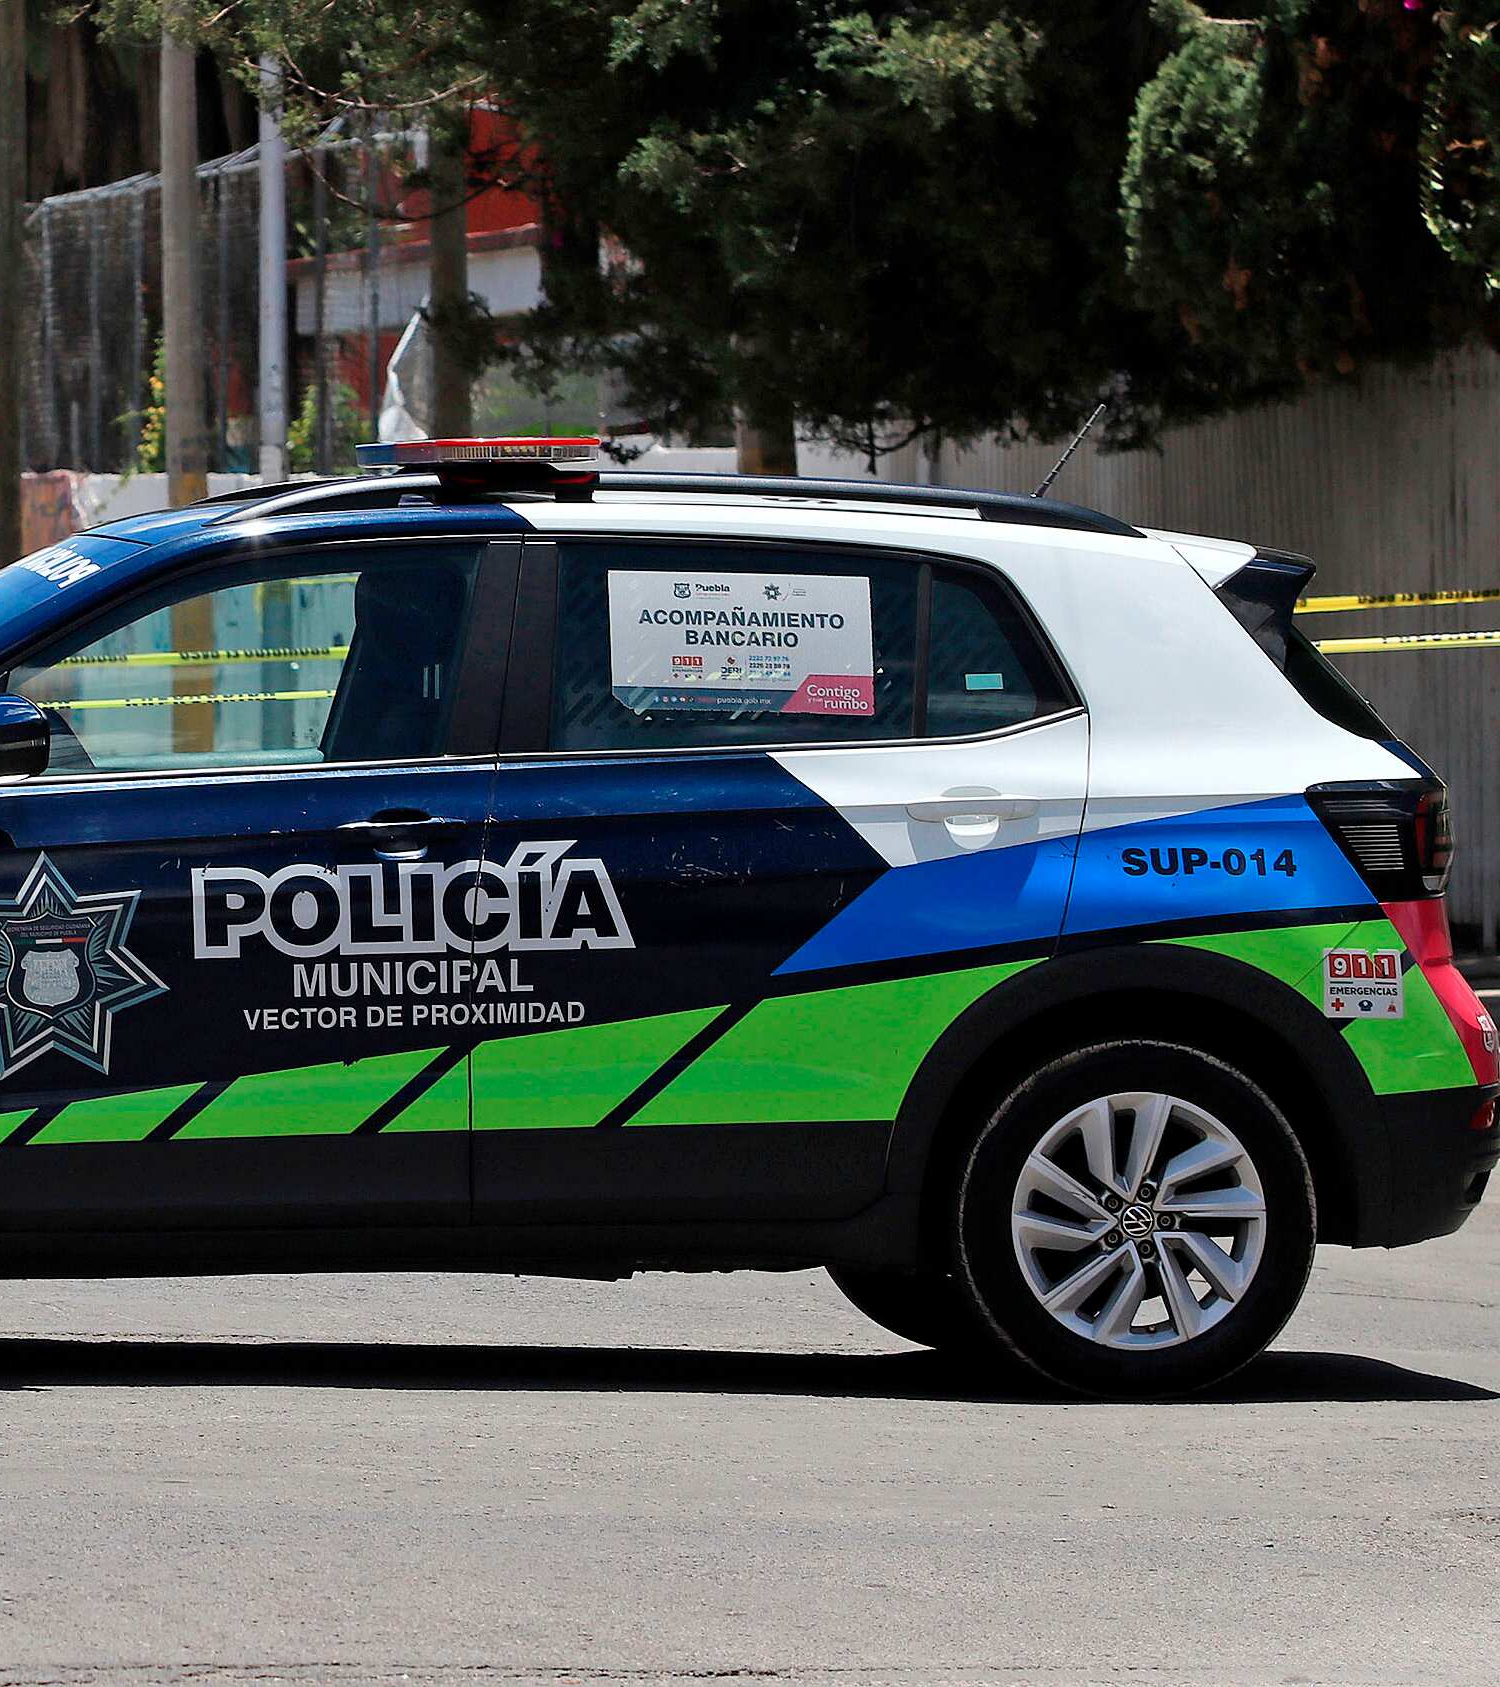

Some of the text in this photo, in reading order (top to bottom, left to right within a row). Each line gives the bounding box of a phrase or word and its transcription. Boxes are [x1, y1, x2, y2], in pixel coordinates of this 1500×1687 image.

[695, 583, 731, 592] Puebla
[638, 607, 845, 629] ACOMPAÑAMIENTO
[685, 630, 799, 648] BANCARIO
[673, 656, 702, 666] 911
[806, 684, 860, 700] Contigo
[823, 698, 869, 710] rumbo
[1121, 847, 1297, 877] SUP-014
[190, 840, 637, 959] POLICÍA
[1332, 957, 1390, 976] 911
[292, 958, 534, 998] MUNICIPAL
[1329, 986, 1398, 996] EMERGENCIAS
[243, 1001, 586, 1031] VECTOR DE PROXIMIDAD
